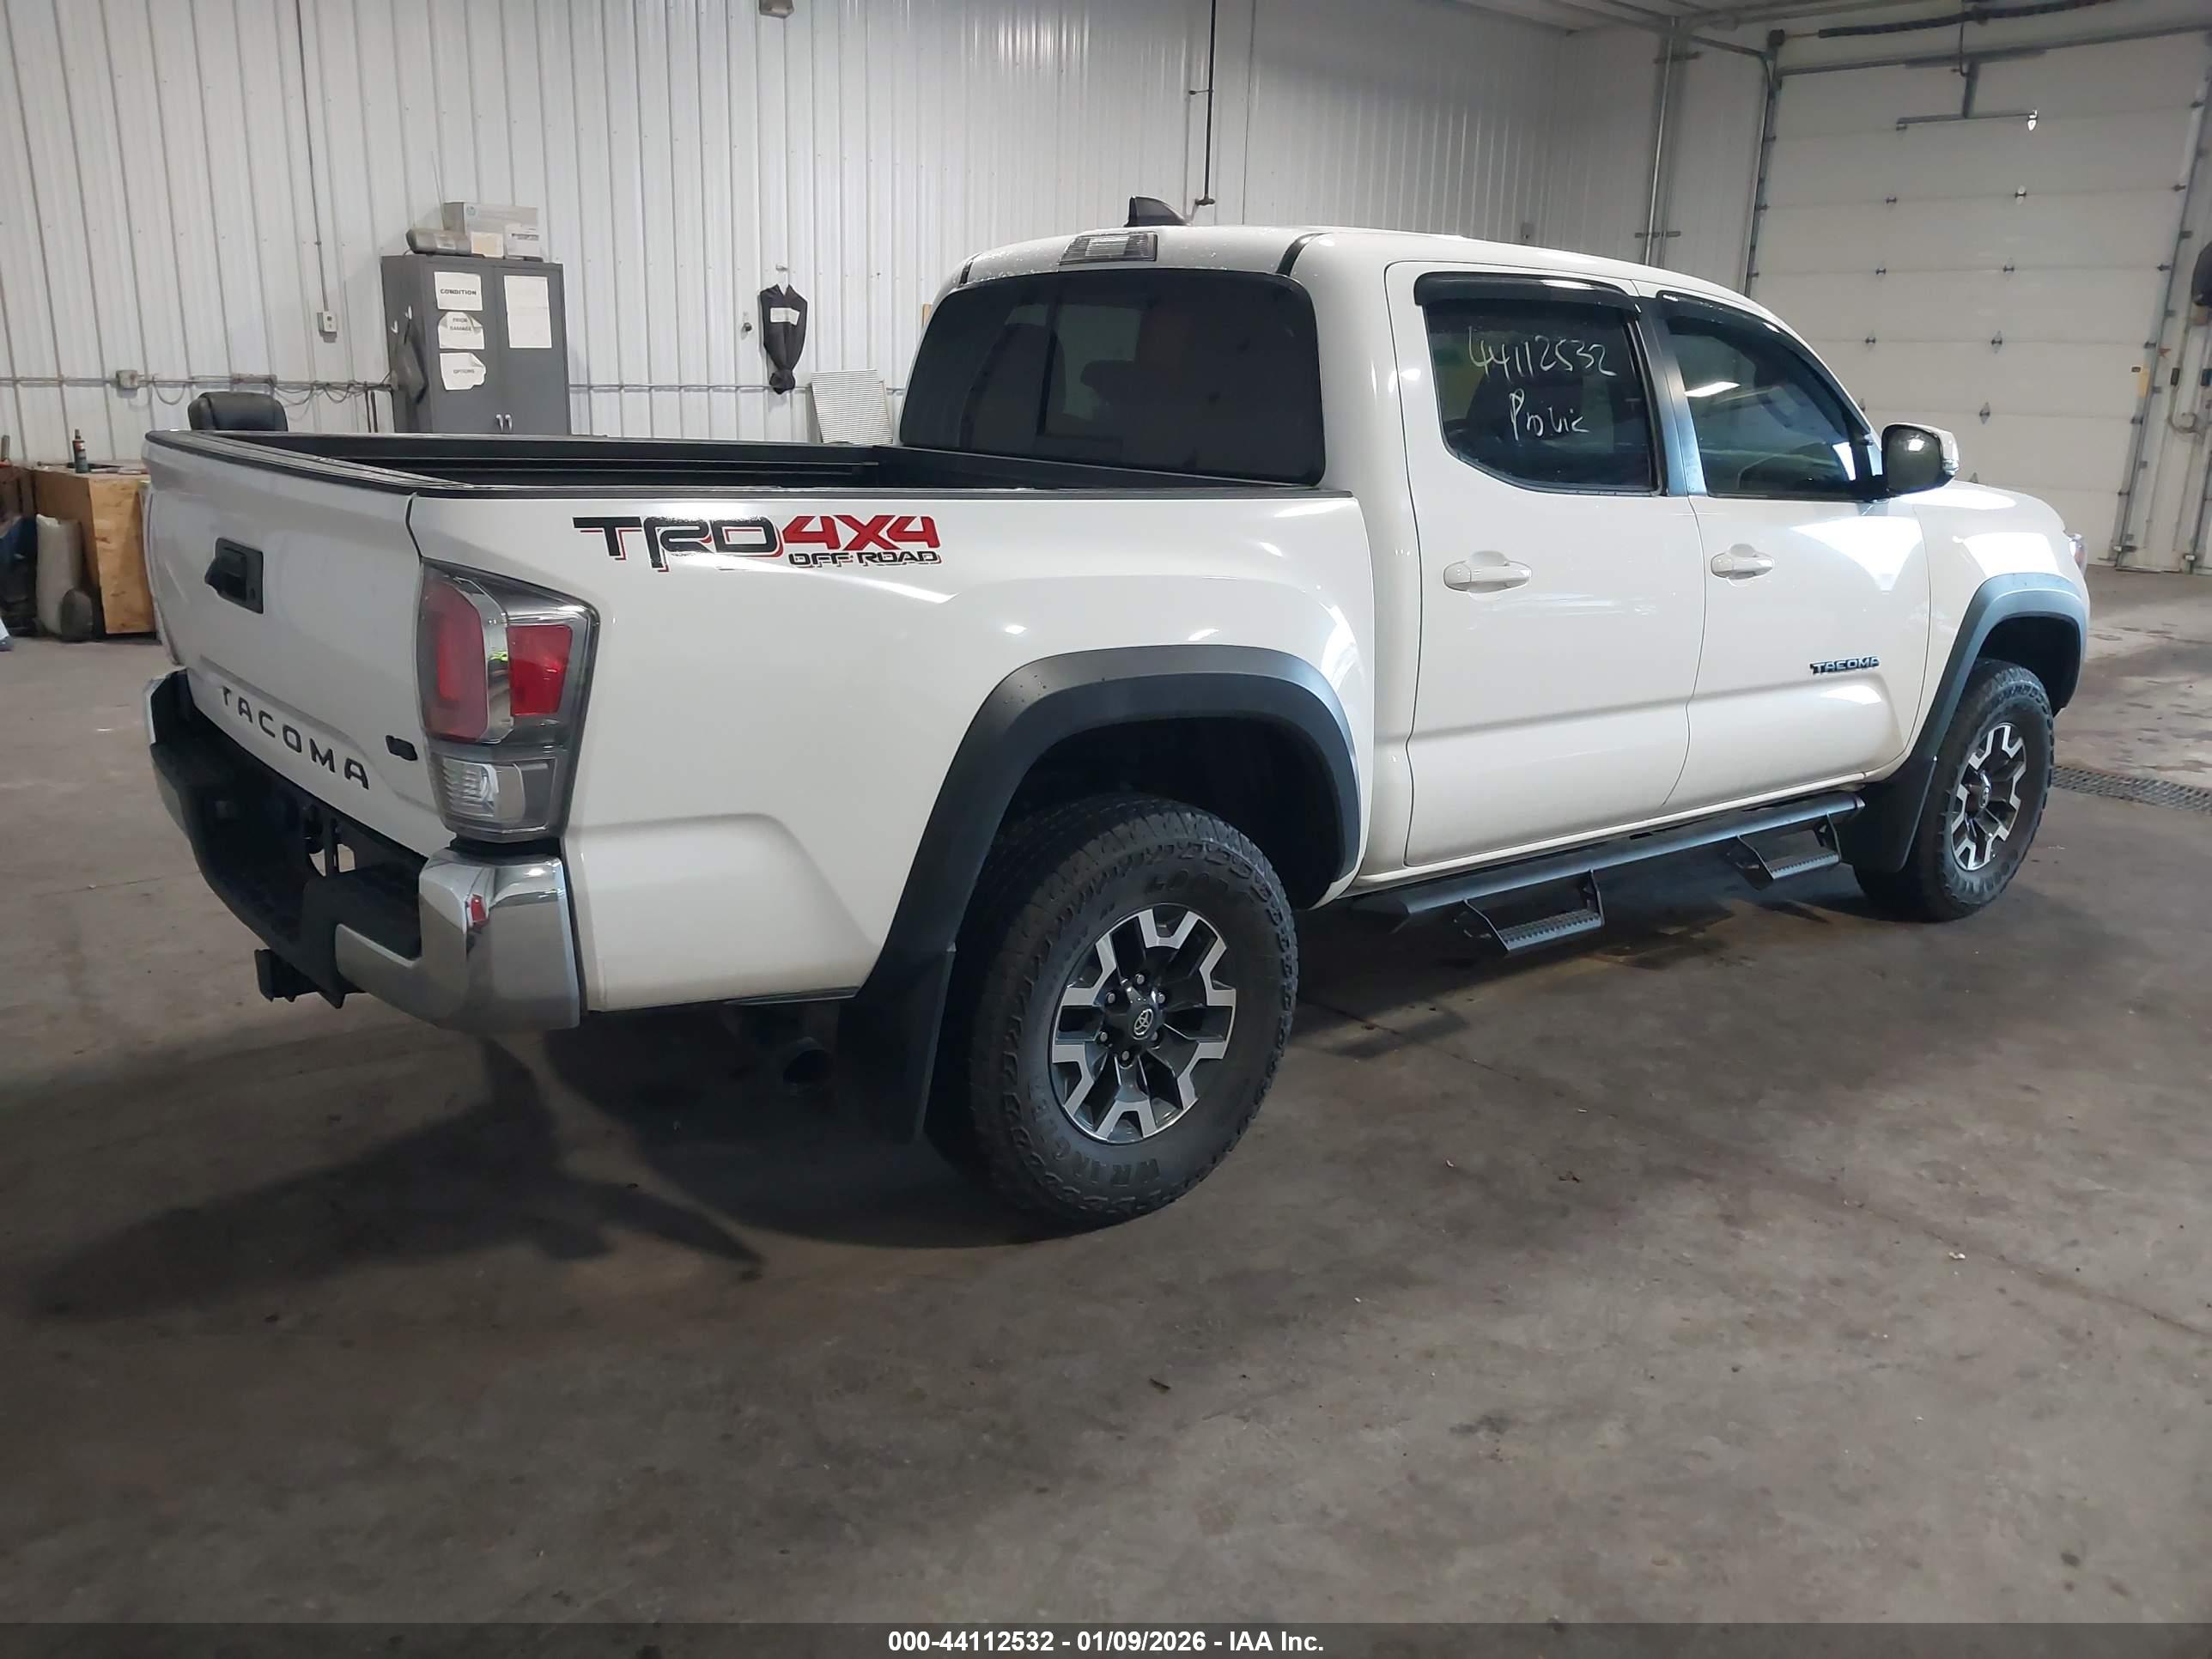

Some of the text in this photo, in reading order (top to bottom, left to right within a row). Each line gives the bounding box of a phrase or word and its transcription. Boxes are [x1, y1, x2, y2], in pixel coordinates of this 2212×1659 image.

[1468, 325, 1617, 380] 44112532
[573, 514, 942, 573] TRD 4X4
[788, 551, 942, 568] OFF ROAD
[1809, 656, 1880, 674] TACOMA
[222, 686, 369, 790] TACOMA
